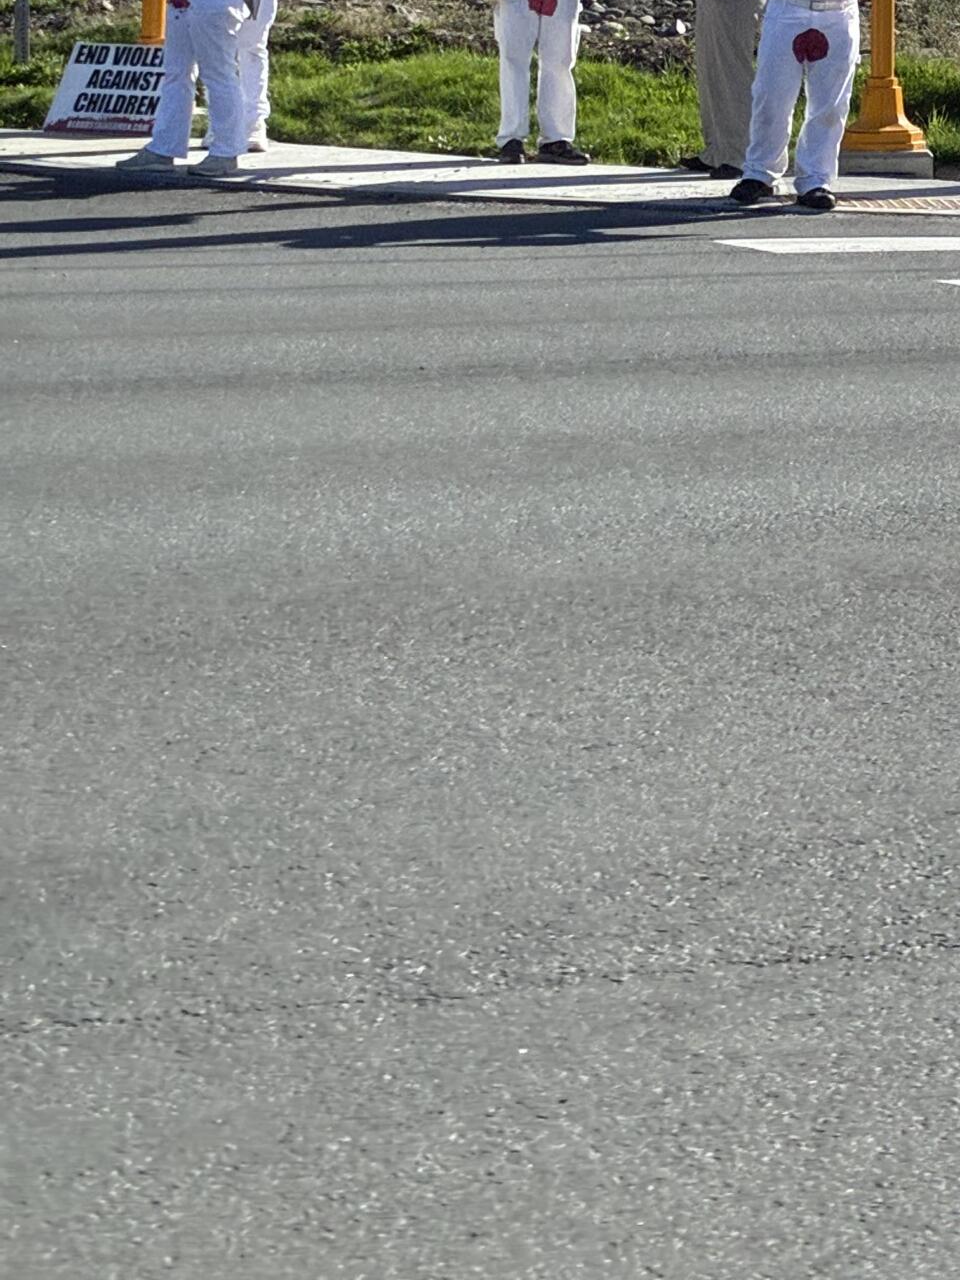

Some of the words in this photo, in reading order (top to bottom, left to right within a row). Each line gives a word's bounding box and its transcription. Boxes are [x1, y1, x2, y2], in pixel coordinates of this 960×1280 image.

[74, 44, 111, 65] END
[112, 45, 165, 68] VIOLE
[85, 68, 166, 92] AGAINST
[73, 92, 161, 115] CHILDREN
